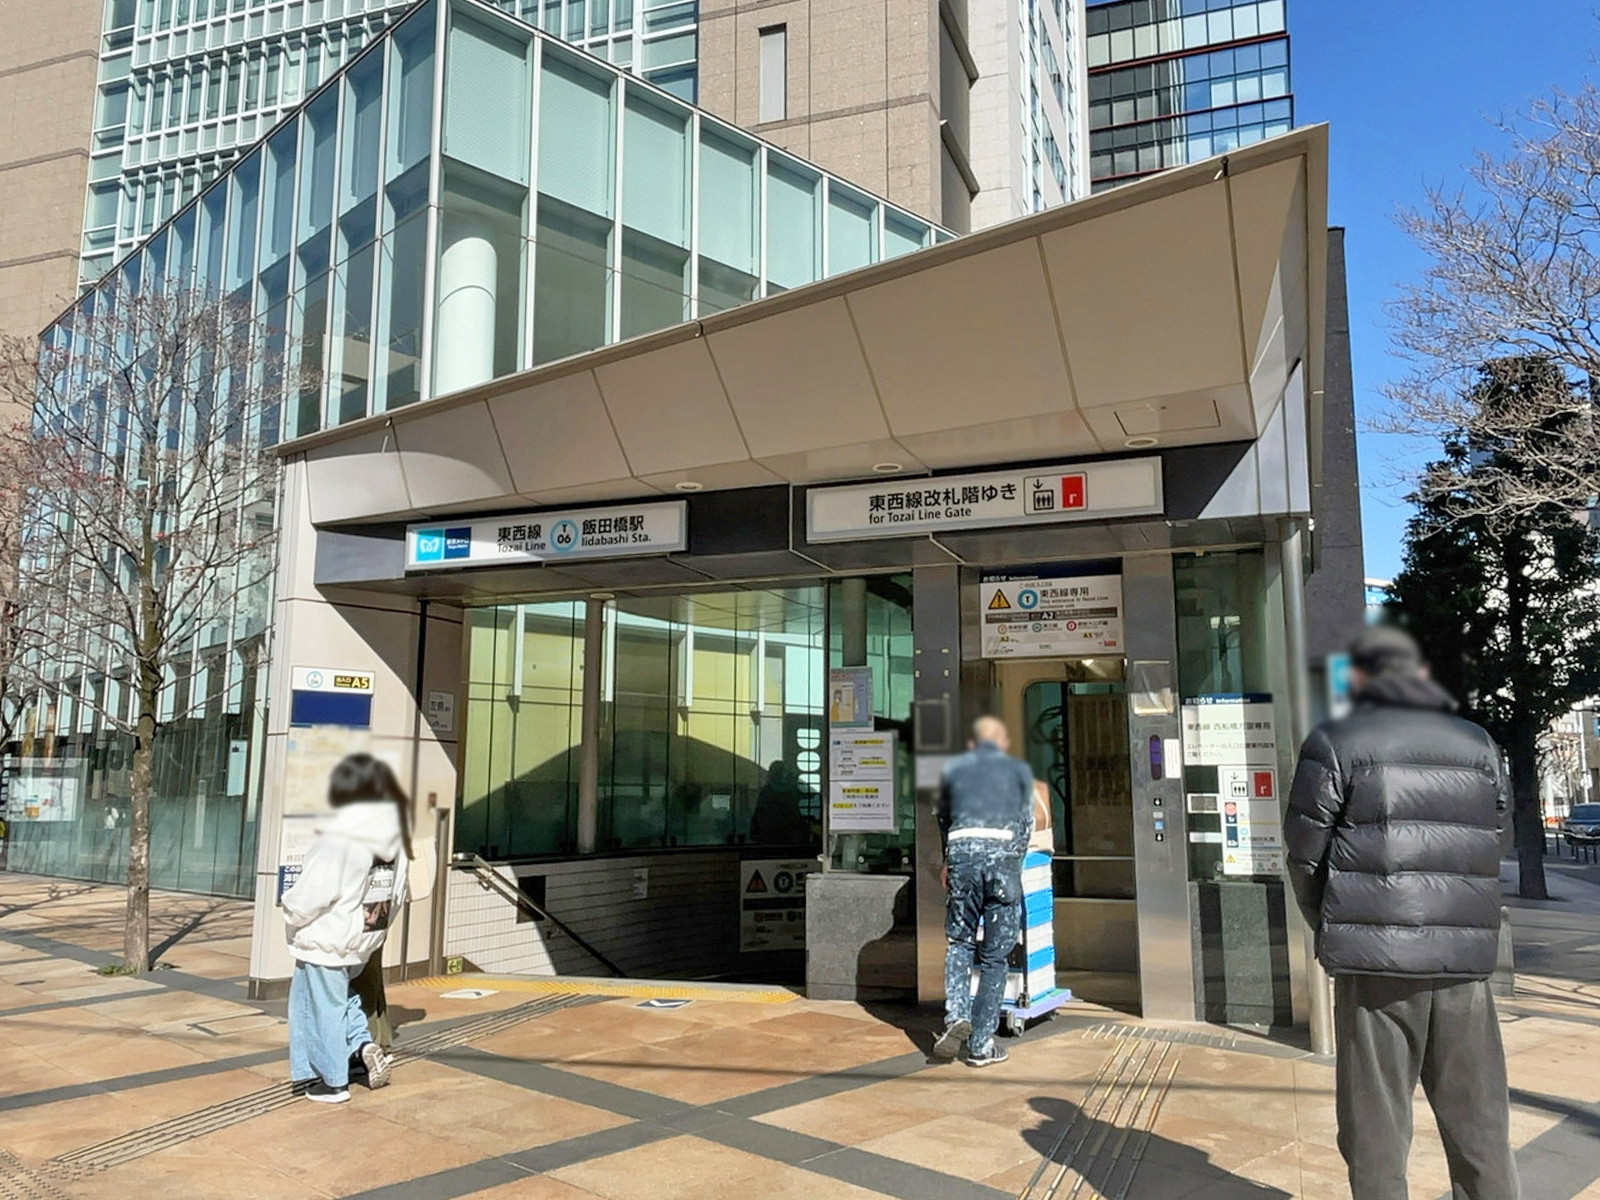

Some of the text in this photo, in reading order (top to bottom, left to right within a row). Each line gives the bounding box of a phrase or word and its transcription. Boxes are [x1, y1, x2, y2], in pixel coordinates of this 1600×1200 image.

[869, 483, 1016, 512] 東西線改札階ゆき
[869, 506, 971, 525] for Tozai Line Gate
[562, 524, 567, 532] T
[582, 515, 644, 535] 飯田橋駅
[498, 525, 541, 541] 東西線
[557, 534, 571, 544] 06
[581, 533, 651, 546] Iidabashi Sta.
[498, 542, 546, 552] Tozai Line
[1040, 587, 1089, 598] 東西線専用
[1041, 611, 1053, 620] A2
[352, 677, 369, 688] A5
